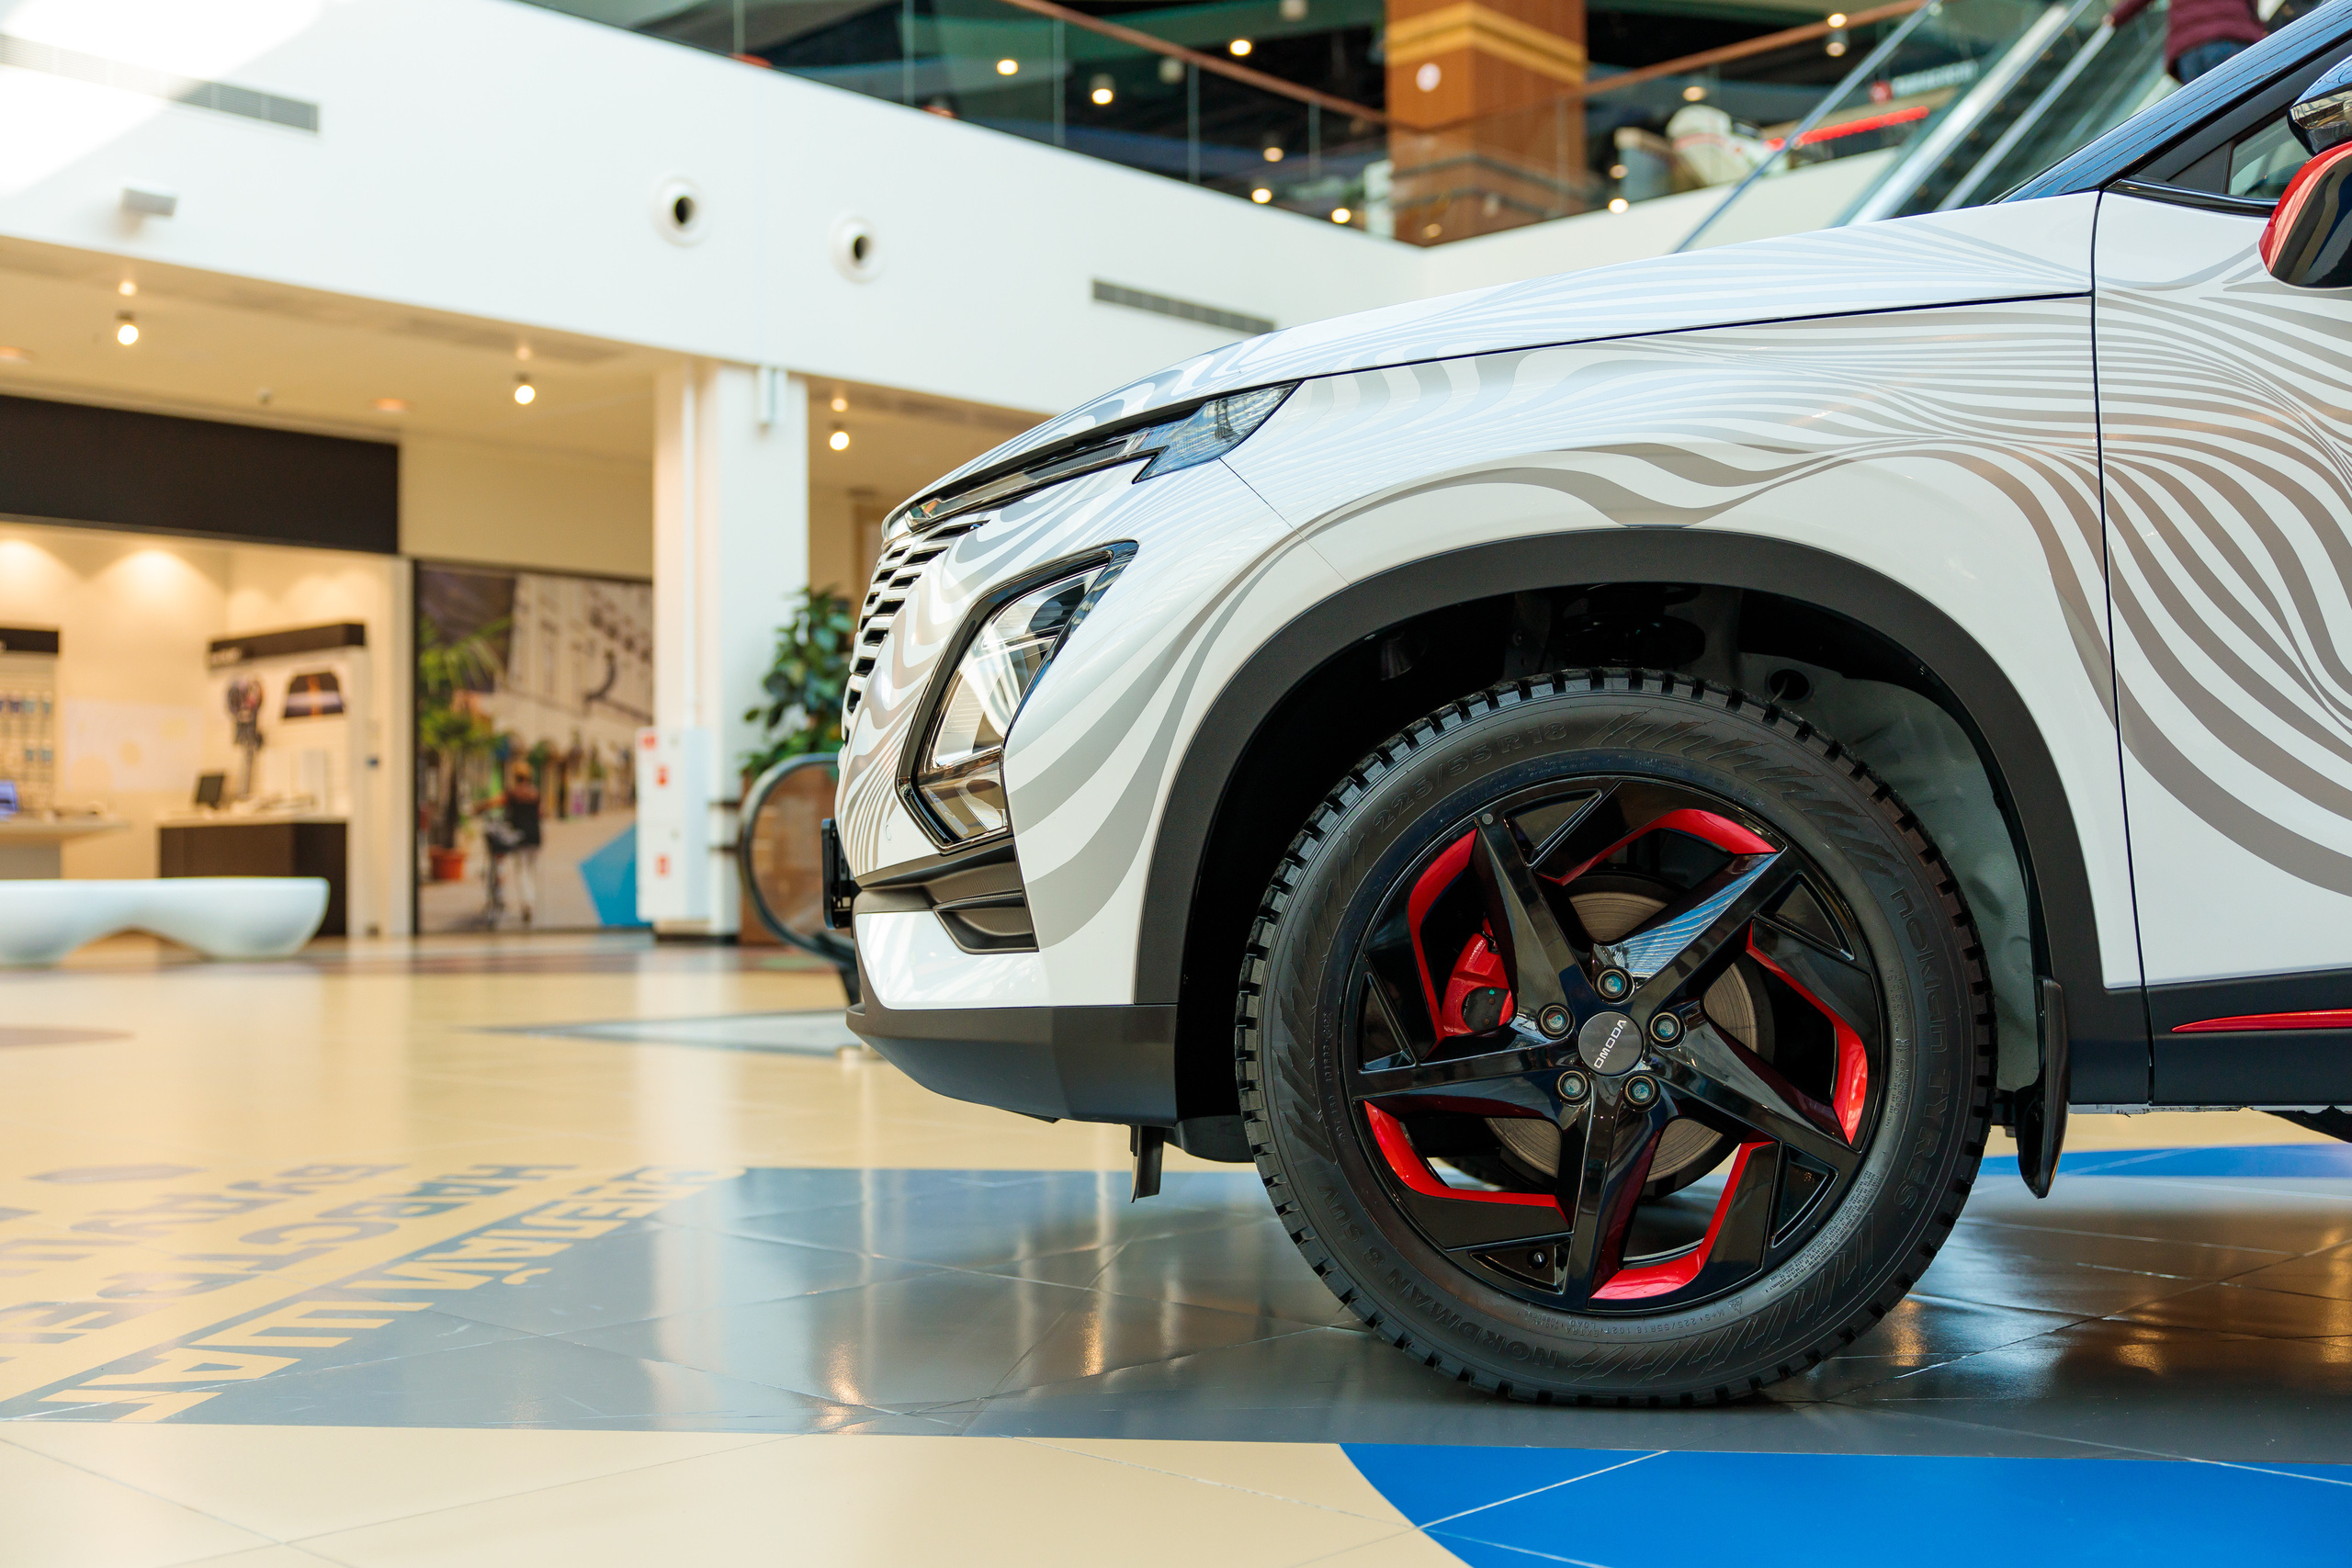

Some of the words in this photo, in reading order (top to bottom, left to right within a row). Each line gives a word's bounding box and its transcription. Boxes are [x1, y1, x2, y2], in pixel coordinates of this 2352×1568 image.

[1888, 886, 1948, 1055] nokian
[1594, 1020, 1627, 1068] OMODA
[1889, 1066, 1951, 1214] TYRES
[1315, 1178, 1367, 1246] SUV
[1359, 1243, 1387, 1271] 8
[39, 1301, 434, 1422] ШАГ
[1382, 1266, 1559, 1369] NORDMAN
